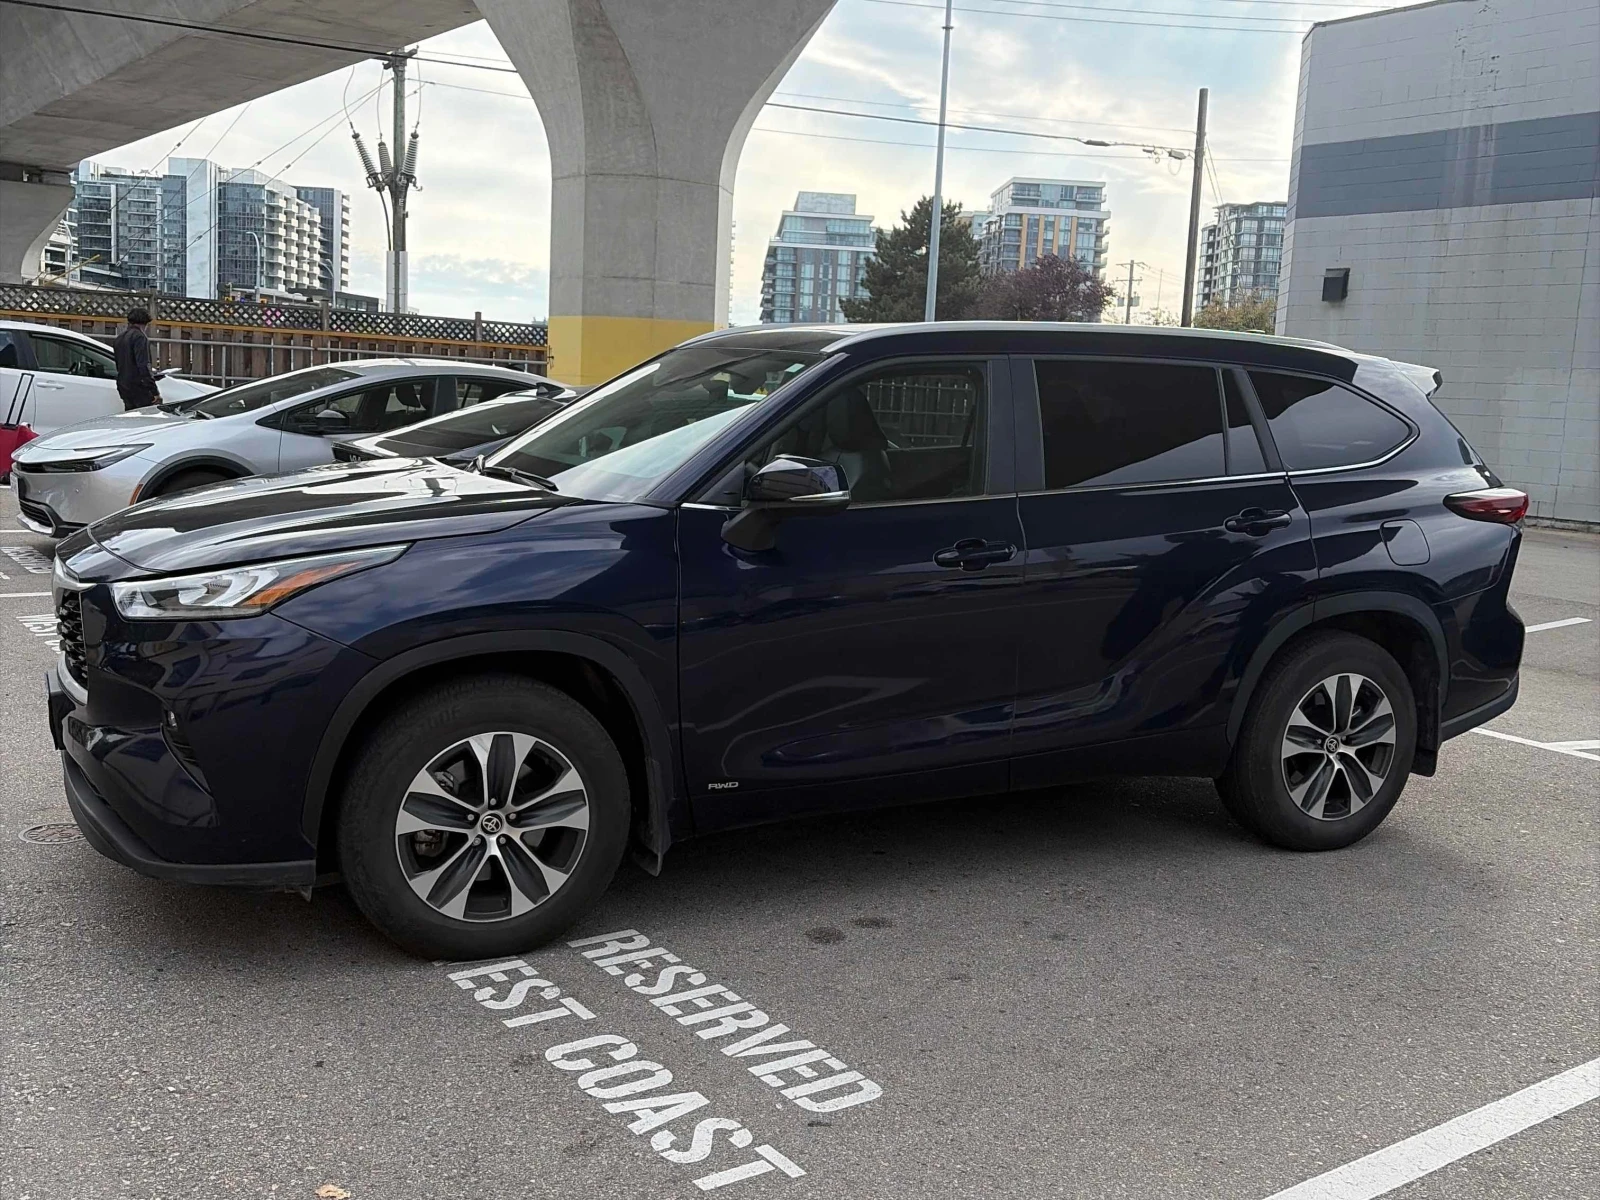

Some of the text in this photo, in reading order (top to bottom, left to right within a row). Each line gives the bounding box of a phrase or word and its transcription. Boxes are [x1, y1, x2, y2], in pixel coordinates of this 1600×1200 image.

[708, 781, 739, 790] AWD
[432, 956, 807, 1191] EST COAST
[566, 929, 883, 1113] RESERVED
